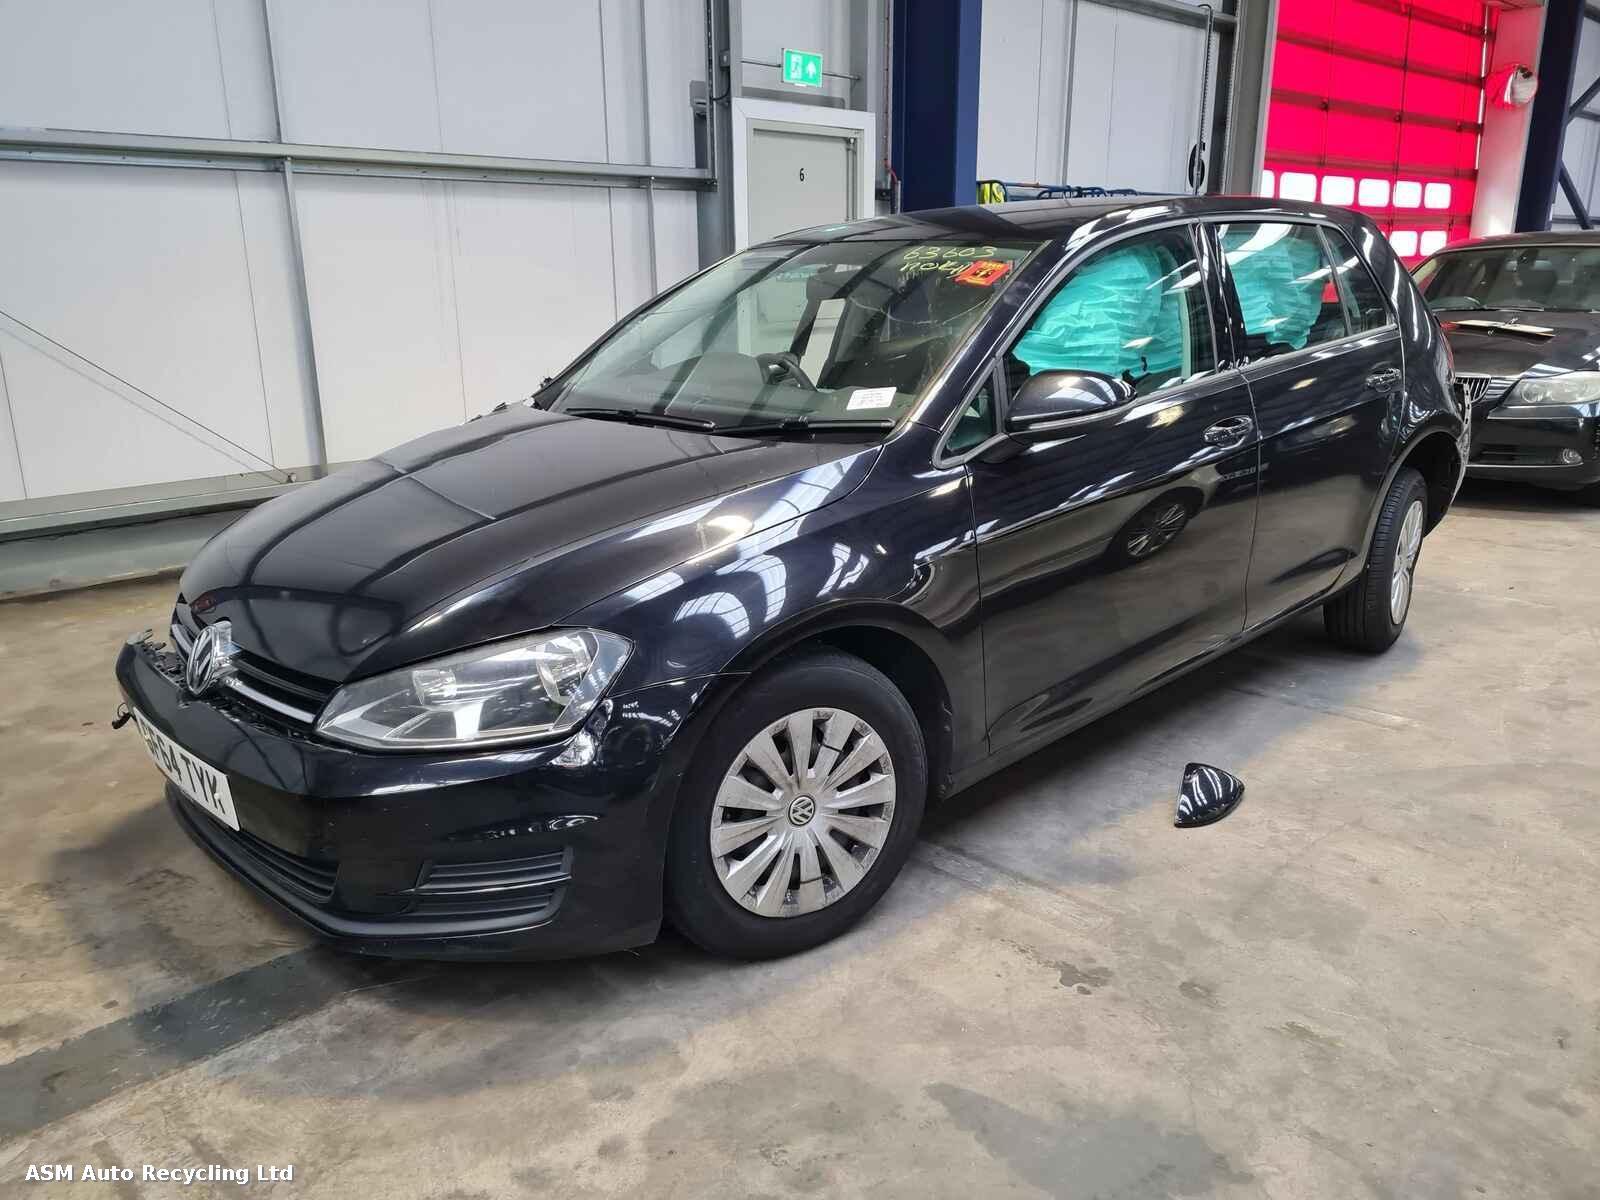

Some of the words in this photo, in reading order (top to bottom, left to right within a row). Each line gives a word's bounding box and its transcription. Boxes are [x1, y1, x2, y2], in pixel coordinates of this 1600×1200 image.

[799, 167, 805, 182] 6
[903, 245, 998, 260] 63603
[180, 752, 226, 815] TYK
